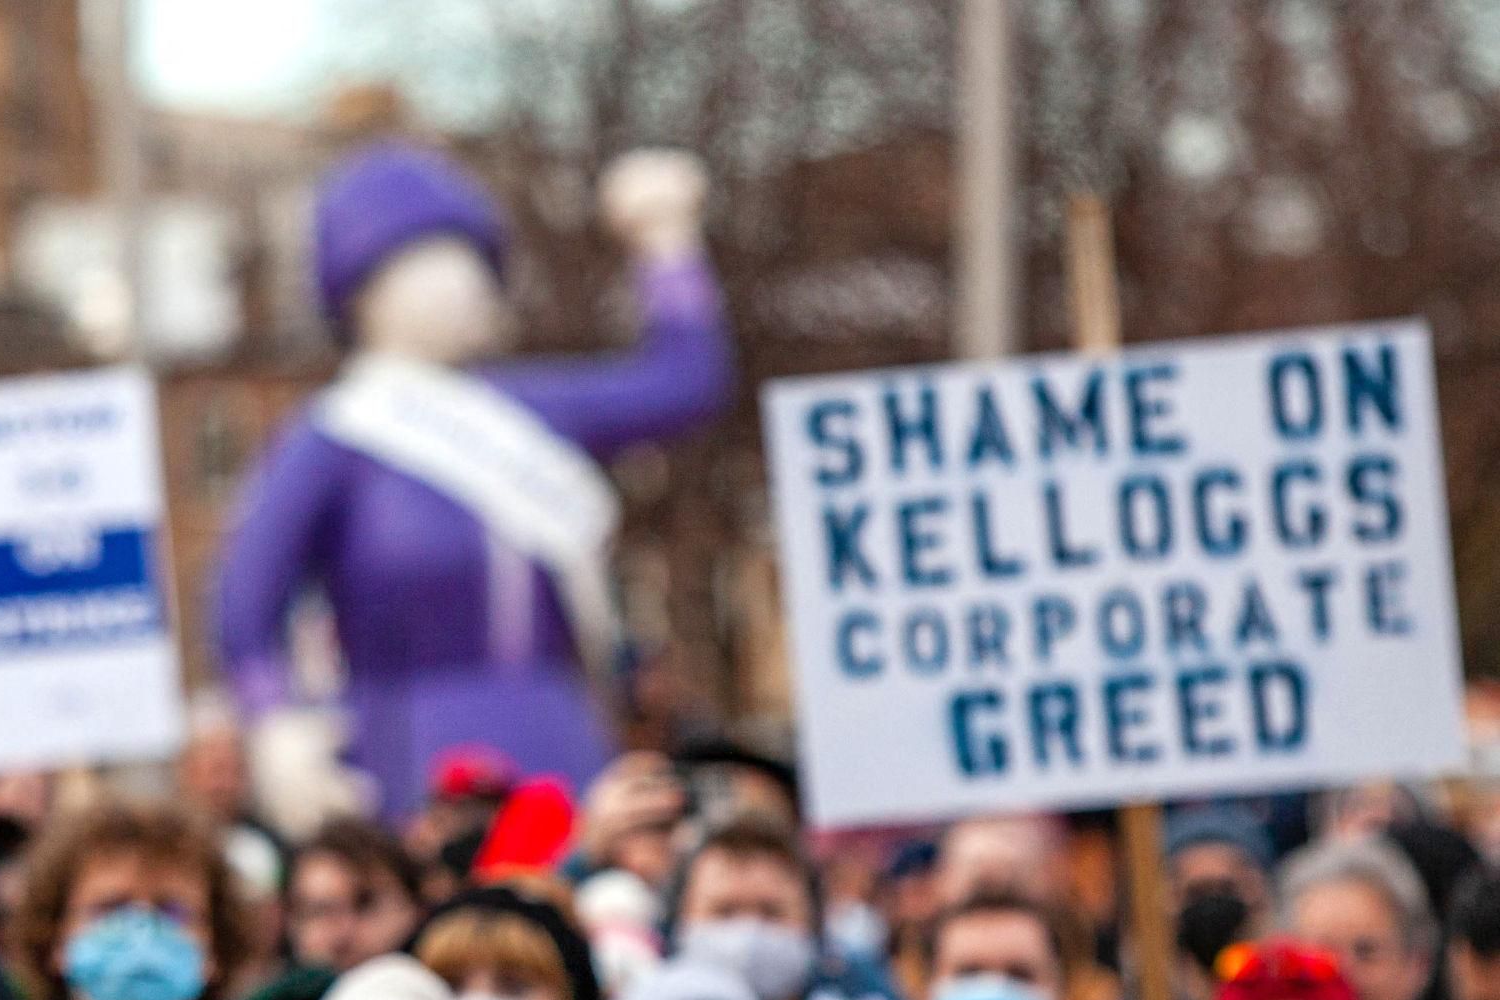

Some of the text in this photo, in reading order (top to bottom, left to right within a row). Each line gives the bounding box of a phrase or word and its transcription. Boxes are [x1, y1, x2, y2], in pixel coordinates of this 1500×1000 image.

[804, 342, 1402, 488] SHAME ON
[823, 457, 1403, 592] KELLOGGS
[836, 561, 1415, 679] CORPORATE
[948, 662, 1311, 777] GREED
